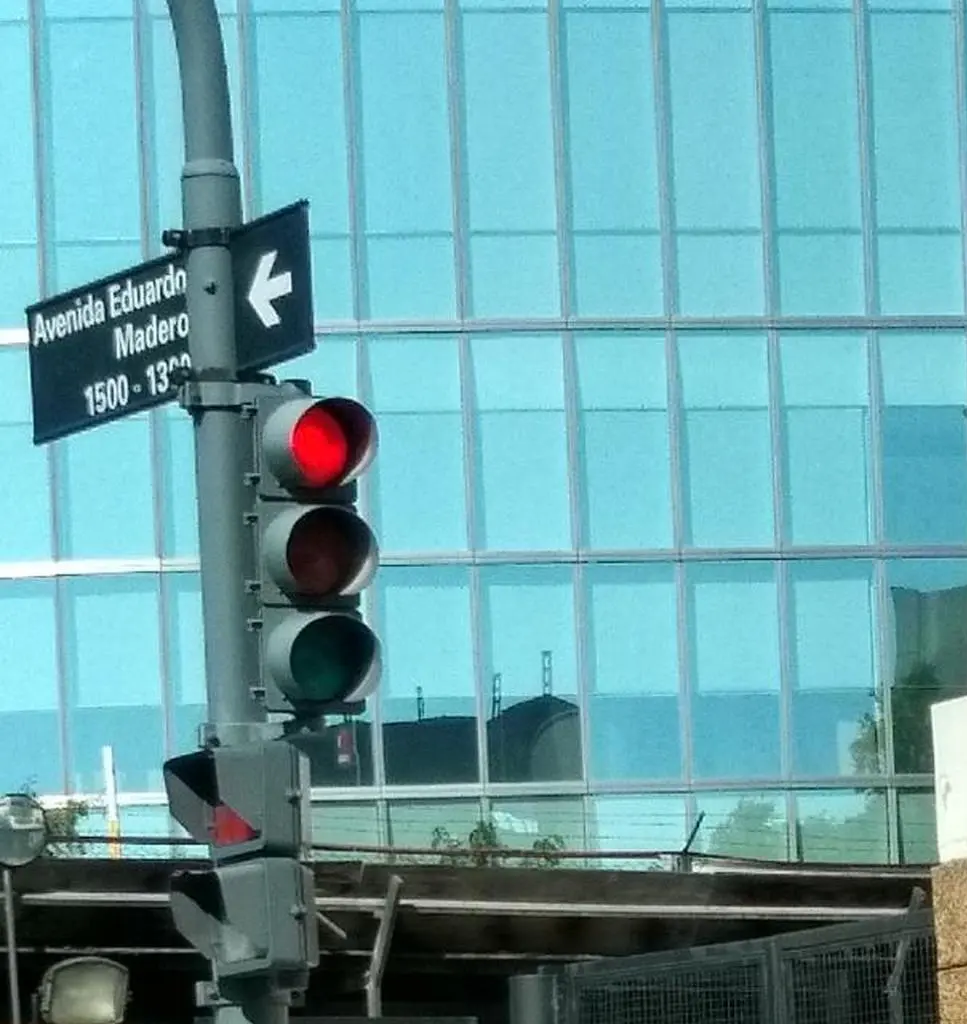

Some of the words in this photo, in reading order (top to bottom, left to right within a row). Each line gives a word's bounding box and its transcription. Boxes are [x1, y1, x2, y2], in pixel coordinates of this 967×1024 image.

[33, 294, 106, 346] Avenida
[109, 264, 186, 317] Eduardo
[113, 312, 189, 359] Madero
[83, 374, 129, 416] 1500
